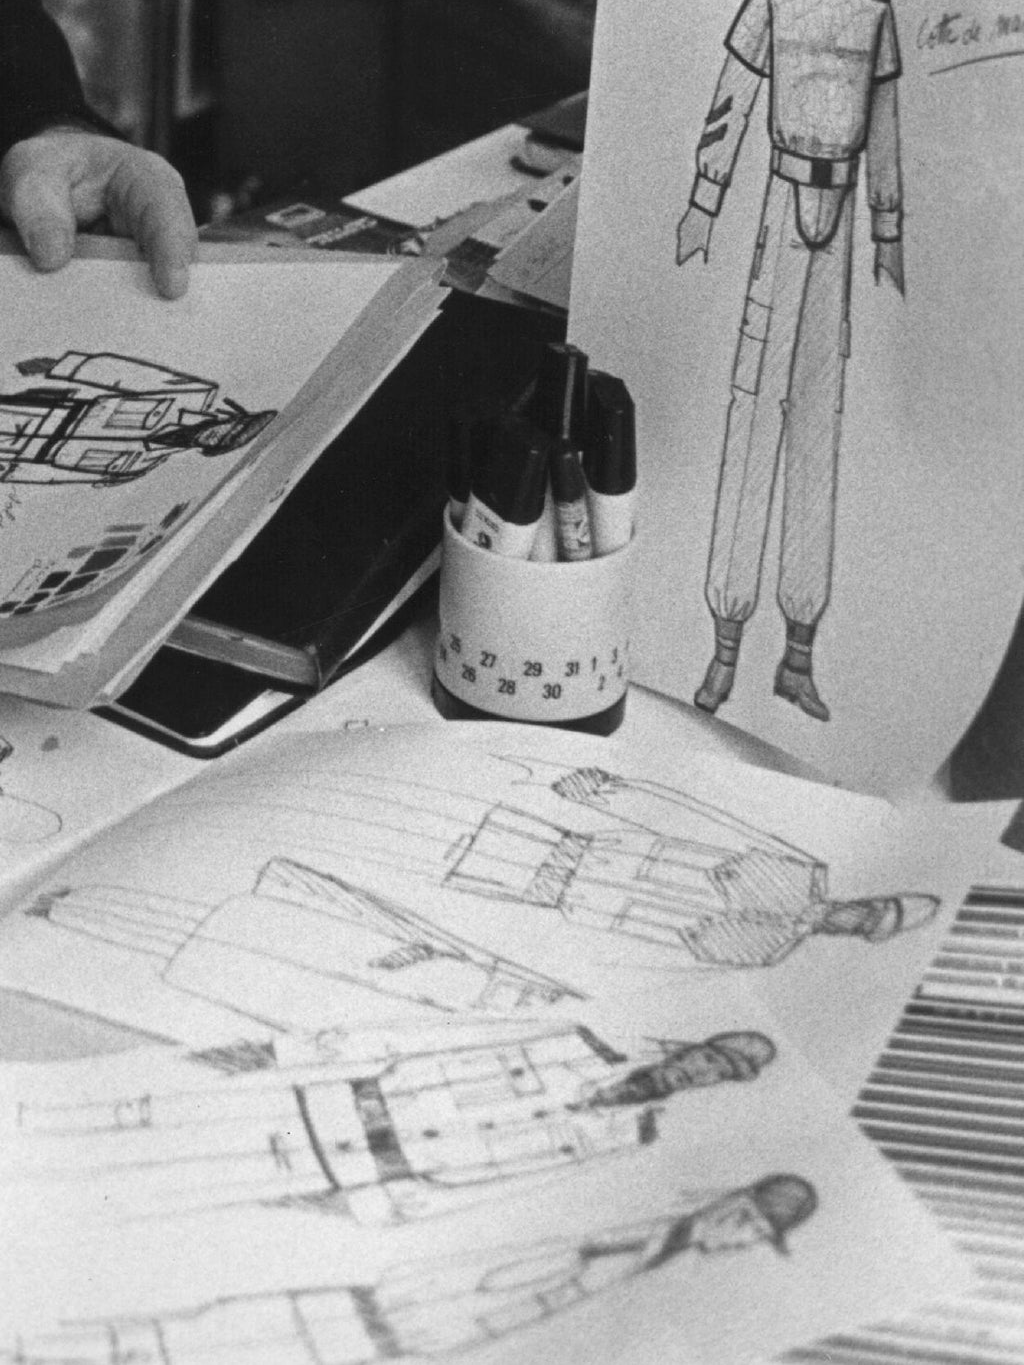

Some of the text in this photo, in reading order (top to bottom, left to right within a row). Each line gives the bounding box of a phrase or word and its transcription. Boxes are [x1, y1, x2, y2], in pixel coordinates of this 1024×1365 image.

[479, 650, 497, 668] 27
[523, 660, 542, 677] 29
[565, 661, 580, 677] 31
[591, 655, 597, 672] 1
[461, 662, 477, 683] 26
[497, 677, 516, 696] 28
[542, 683, 562, 700] 30
[597, 675, 606, 691] 2
